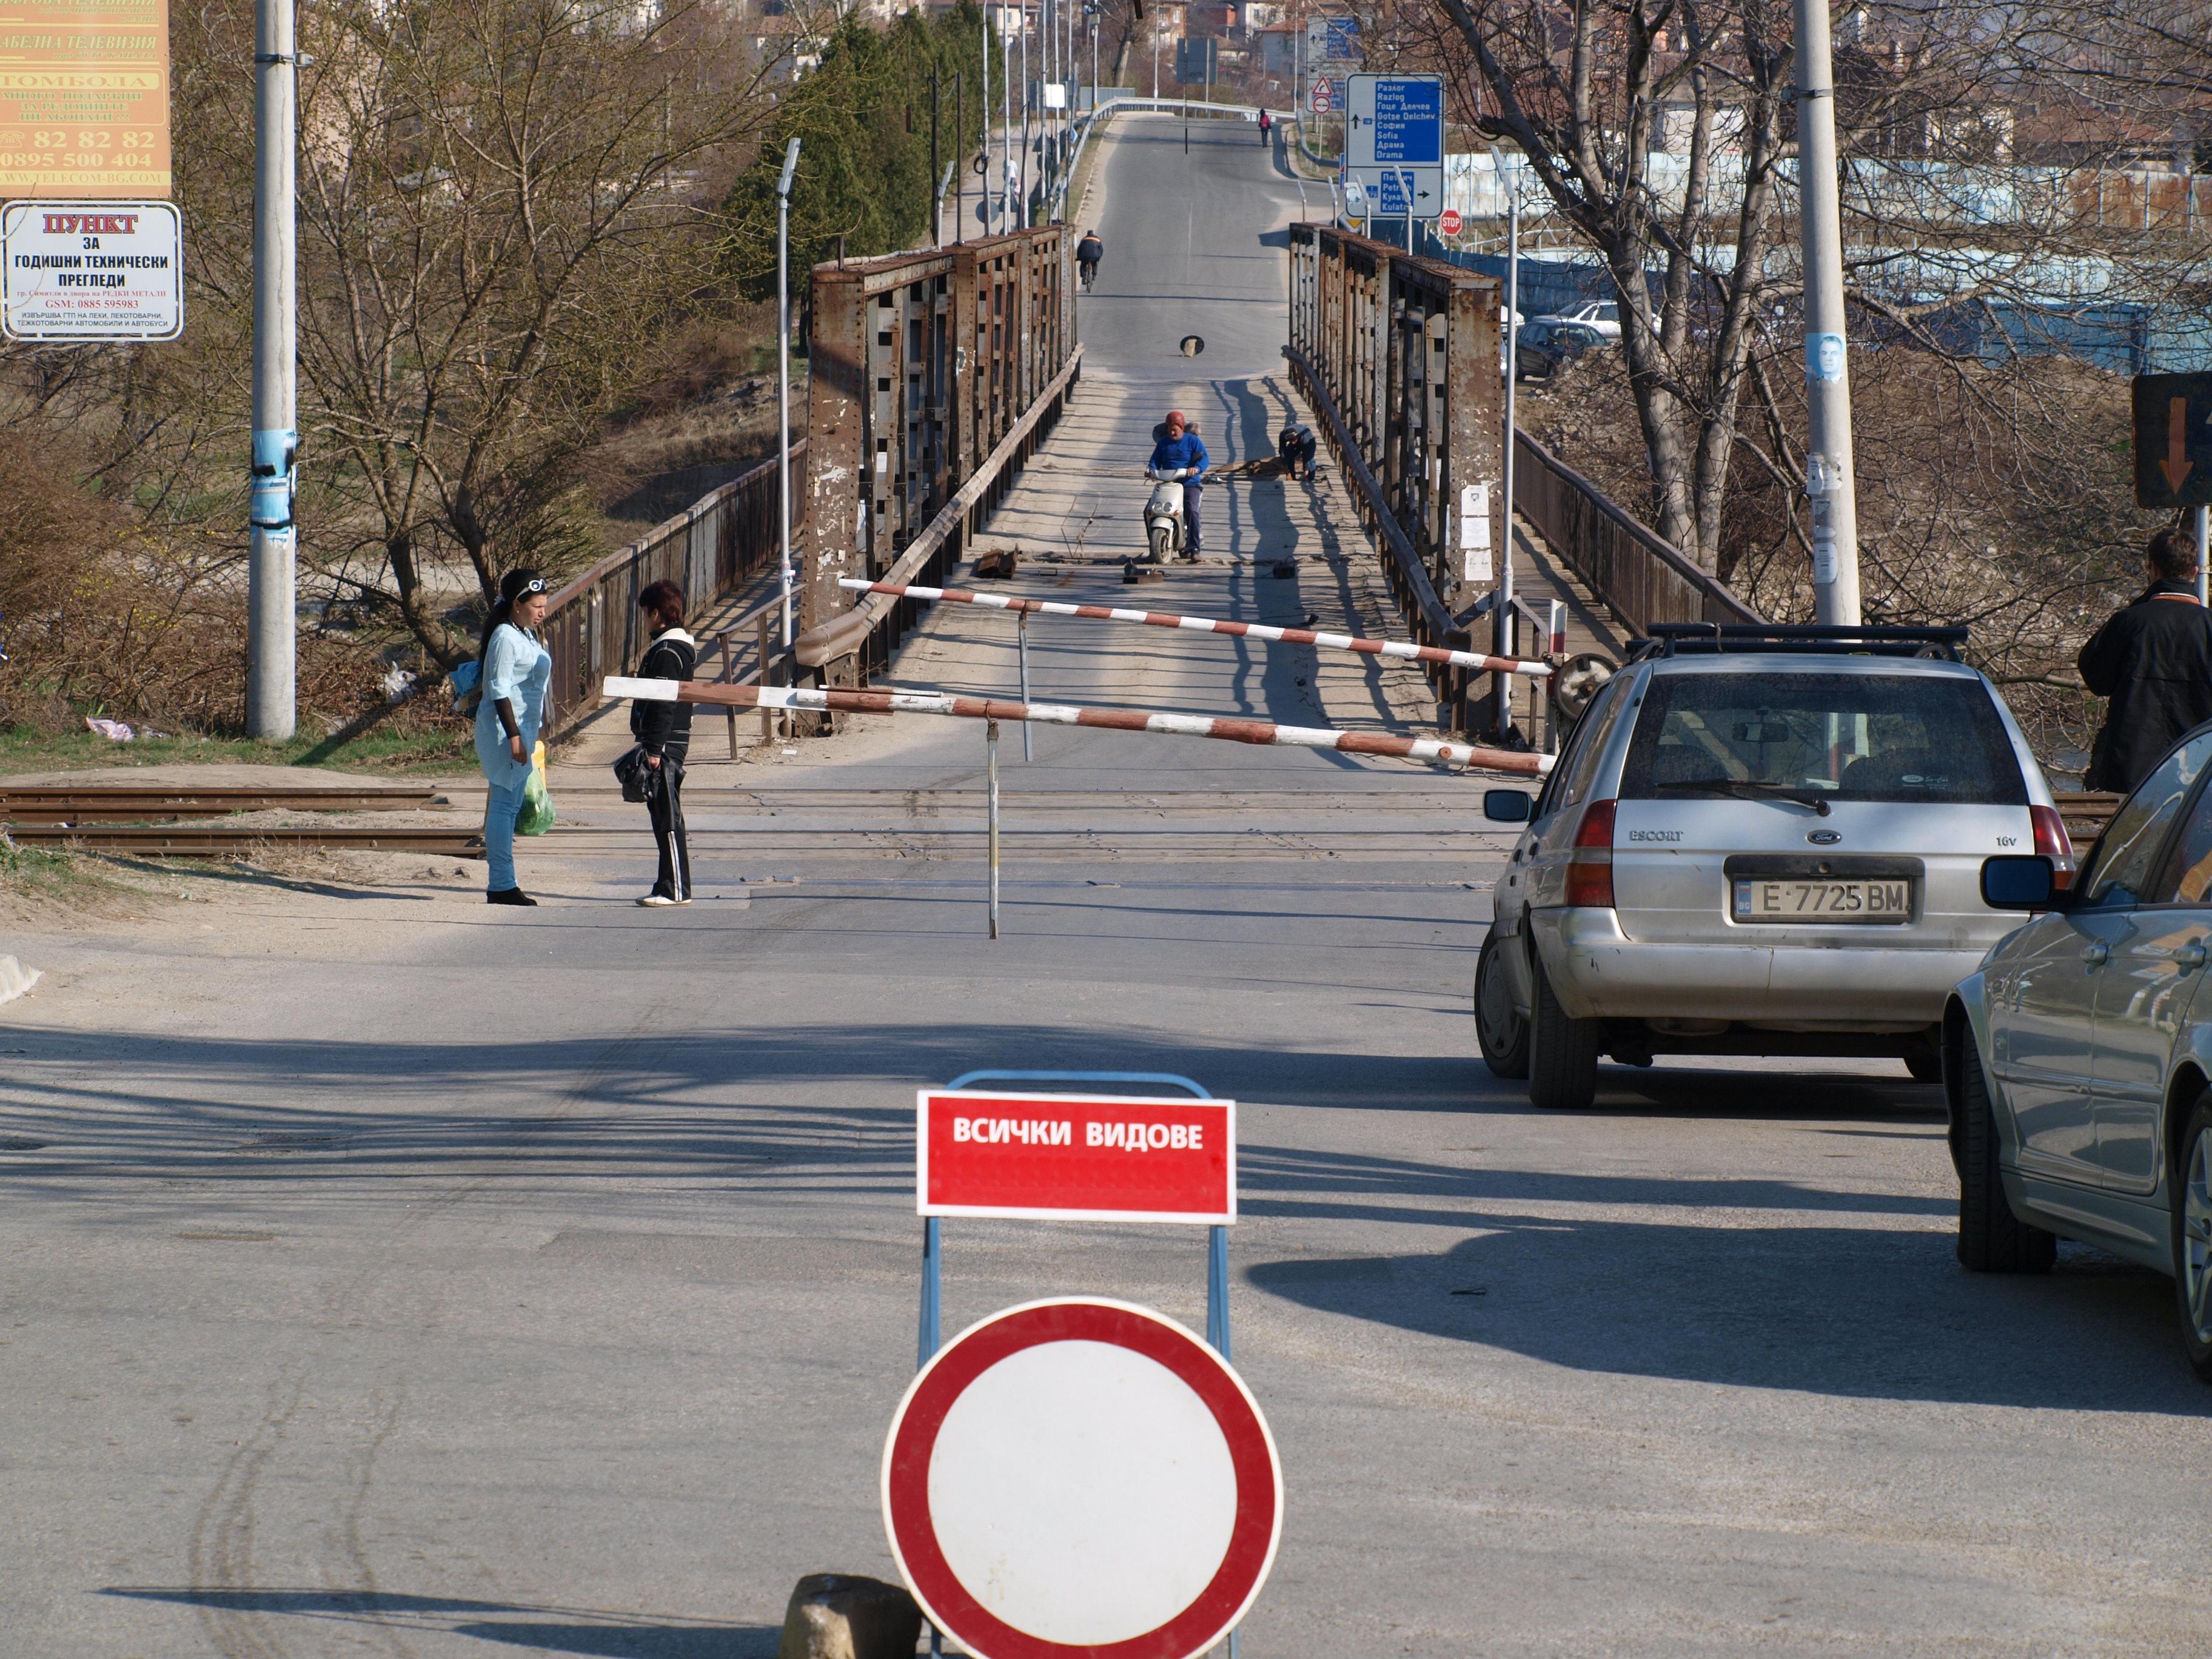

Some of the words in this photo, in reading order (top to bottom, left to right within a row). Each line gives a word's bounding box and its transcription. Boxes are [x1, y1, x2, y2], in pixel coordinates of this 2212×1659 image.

[0, 35, 61, 49] АБЕЛНА
[67, 35, 157, 49] ТЕЛЕВИЗИЯ
[1, 75, 147, 87] ТОМБОЛА
[1378, 93, 1405, 102] Razlog
[1404, 112, 1435, 121] Delchev
[34, 131, 67, 148] 82
[78, 132, 111, 148] 82
[122, 132, 155, 148] 82
[1377, 141, 1404, 150] Драма
[0, 153, 55, 167] 0895
[63, 153, 103, 167] 500
[112, 153, 152, 167] 404
[1383, 184, 1412, 192] Petrh
[43, 214, 138, 234] ПУНКТ
[1443, 218, 1460, 227] STOP
[83, 236, 100, 250] ЗА
[15, 255, 81, 270] ГОДИШНИ
[85, 256, 168, 269] ТЕХНИЧЕСКИ
[59, 274, 125, 289] ПРЕГЛЕДИ
[45, 300, 74, 309] GSM:
[78, 300, 101, 309] 0885
[104, 300, 138, 309] 595983
[1629, 830, 1683, 842] ESCORT
[953, 1118, 1071, 1145] ВСИЧКИ
[1086, 1122, 1204, 1153] ВИДОВЕ
